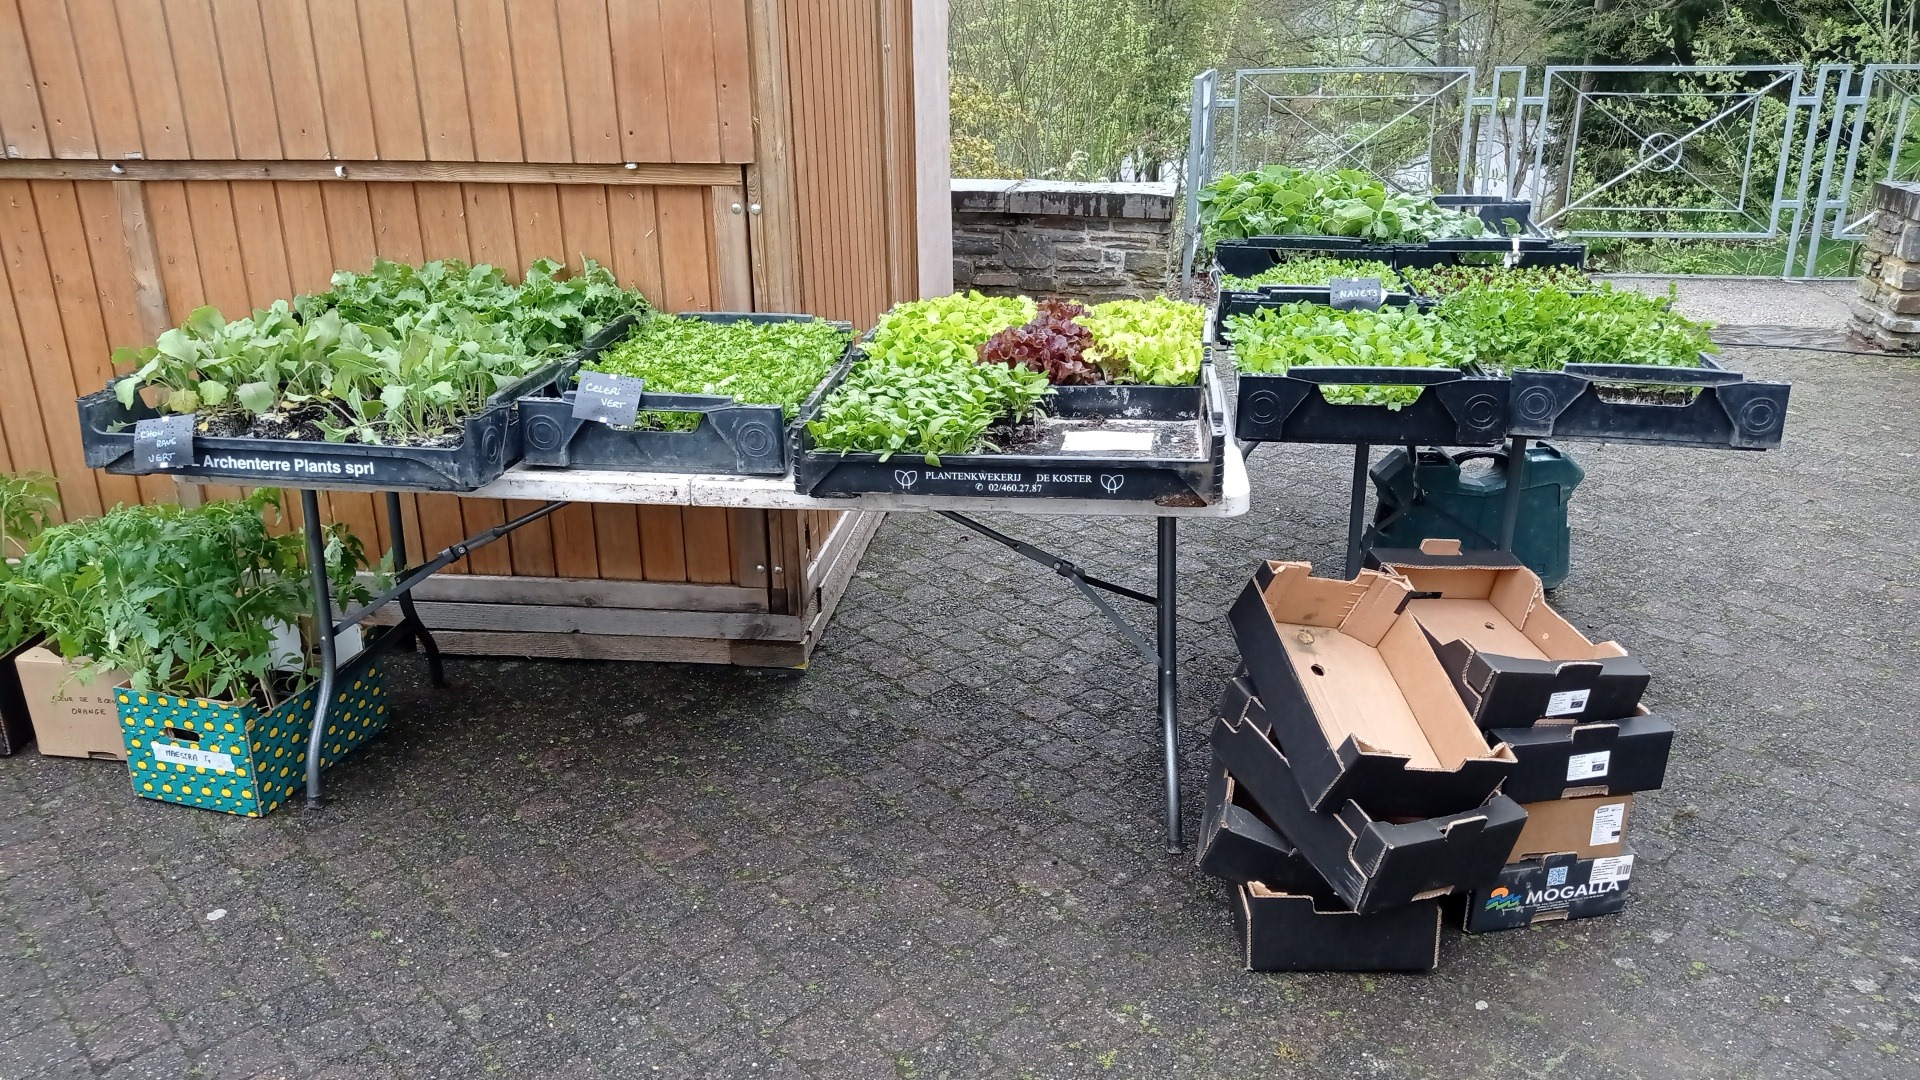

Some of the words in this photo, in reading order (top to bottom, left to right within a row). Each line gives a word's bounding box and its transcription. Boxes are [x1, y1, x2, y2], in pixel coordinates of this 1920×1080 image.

[1340, 289, 1378, 298] NAVETS
[601, 397, 627, 409] VERT
[141, 429, 164, 439] CHOU
[148, 452, 176, 463] VERT
[203, 454, 291, 472] Archenterre
[294, 458, 341, 474] Plants
[345, 461, 375, 477] sprl
[925, 471, 1021, 482] PLANTENKWEKERIJ
[1036, 473, 1050, 483] DE
[1052, 473, 1093, 483] KOSTER
[988, 483, 1042, 493] 02/460.27.87
[1525, 880, 1620, 905] MOGALLA
